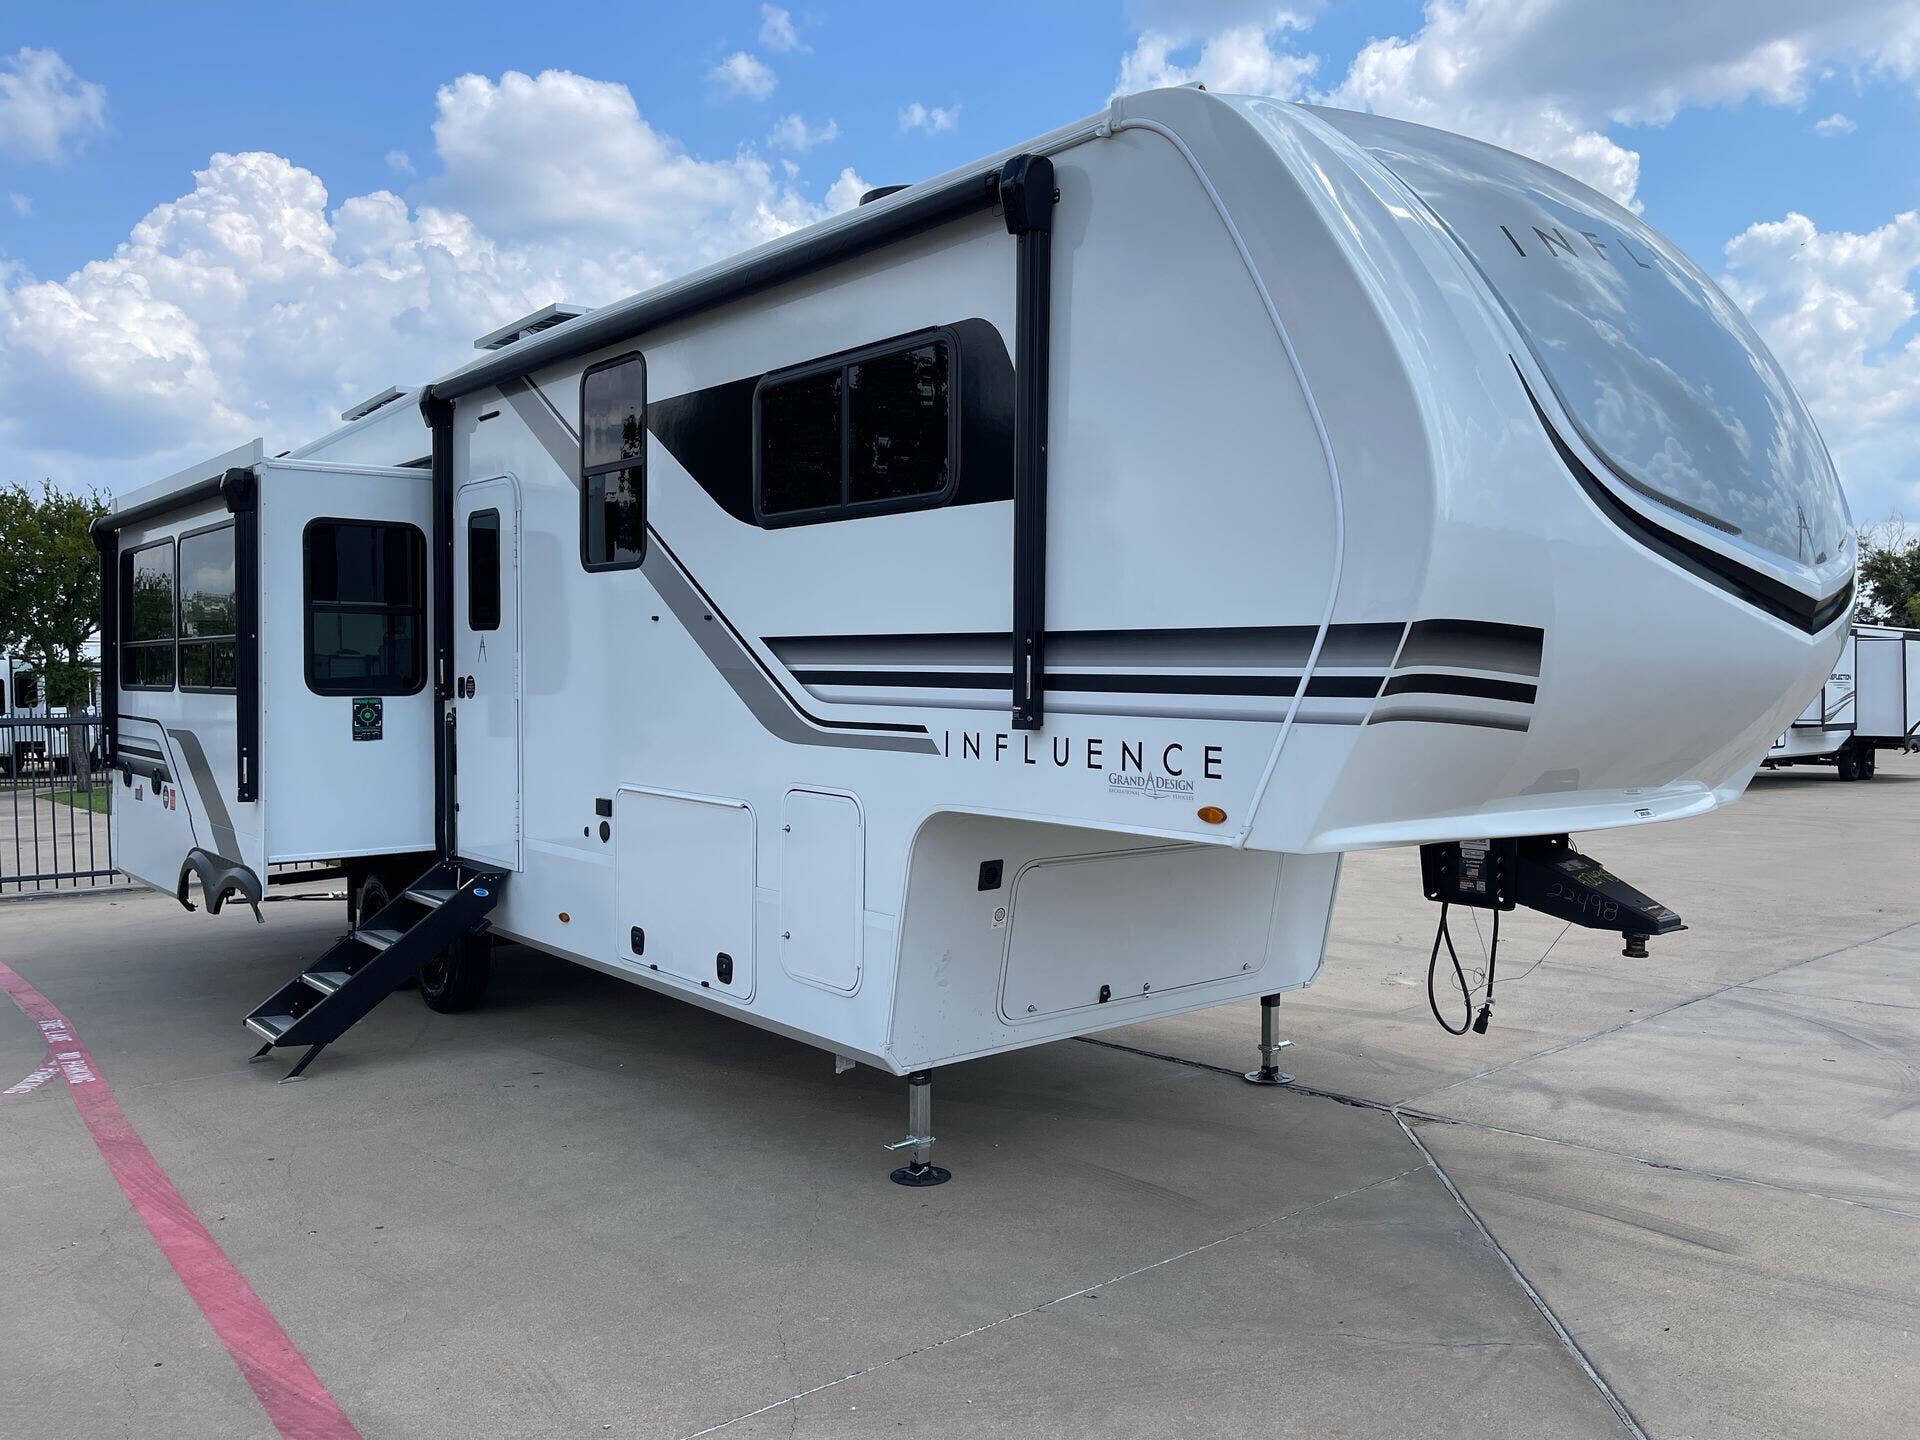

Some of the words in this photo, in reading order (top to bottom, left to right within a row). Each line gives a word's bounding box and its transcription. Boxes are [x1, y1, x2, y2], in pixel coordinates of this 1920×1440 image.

[945, 730, 1223, 780] INFLUENCE
[1108, 772, 1145, 787] GRAND
[1155, 776, 1194, 791] DESIGN
[1545, 882, 1619, 922] 22498
